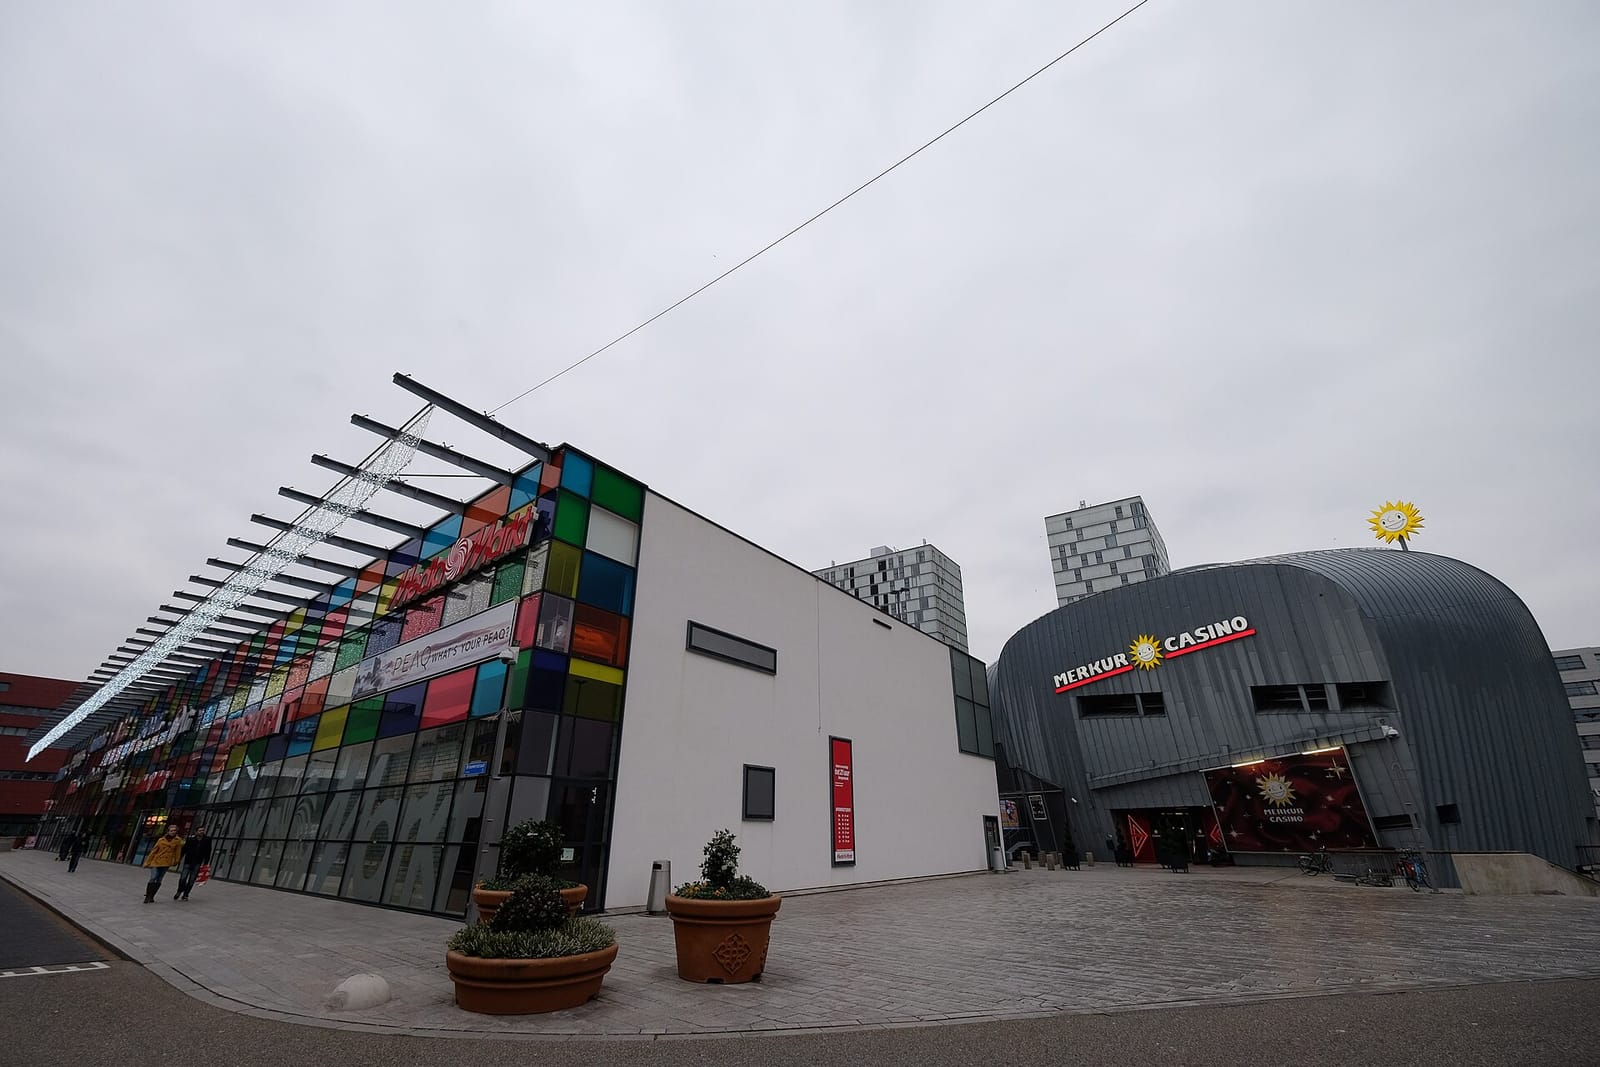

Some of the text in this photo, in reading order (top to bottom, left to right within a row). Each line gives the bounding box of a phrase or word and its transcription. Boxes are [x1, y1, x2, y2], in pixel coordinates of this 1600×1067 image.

[387, 506, 536, 611] Media Markt
[393, 625, 511, 677] PEAQ WHAT'S YOUR PEAQ?
[1053, 615, 1248, 688] MERKUR CASINO
[1263, 807, 1304, 816] MERKUR
[1269, 815, 1304, 823] CASINO
